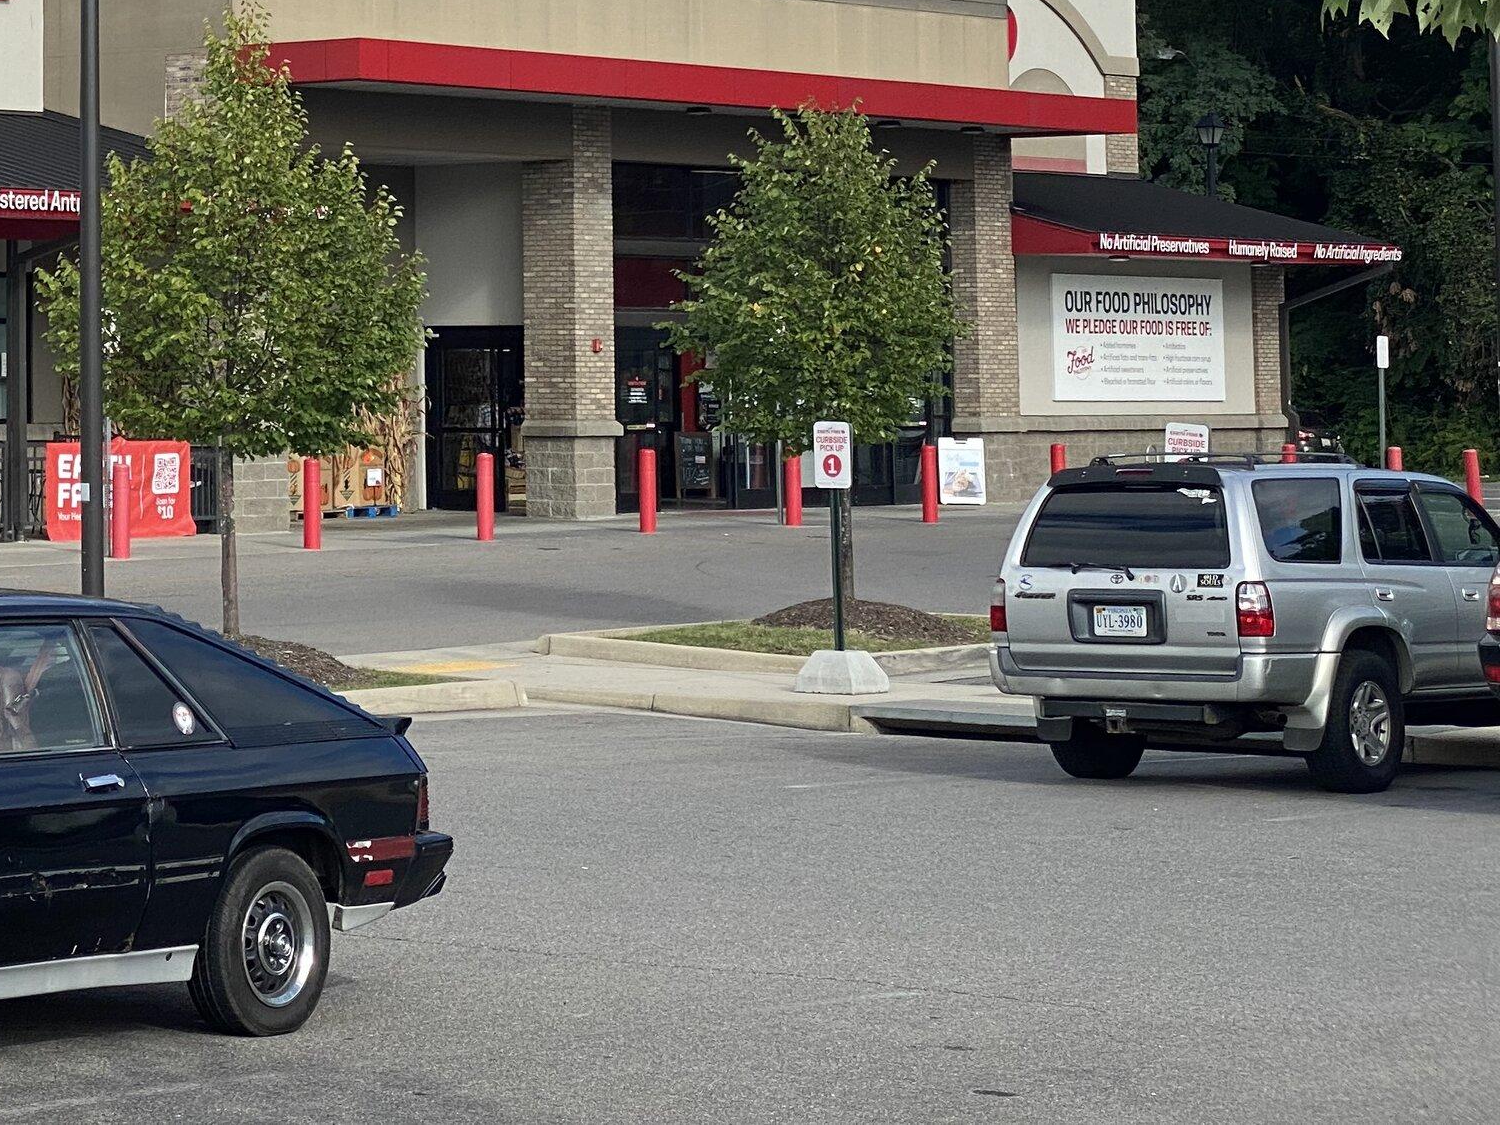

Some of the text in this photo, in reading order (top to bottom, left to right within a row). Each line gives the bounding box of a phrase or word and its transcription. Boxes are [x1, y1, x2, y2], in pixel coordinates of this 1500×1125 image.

[1100, 233, 1210, 254] No Artificial Preservatives
[1228, 239, 1298, 260] Humanely Raised
[1314, 243, 1403, 263] No Artificial Ingredients
[1064, 290, 1212, 316] OUR FOOD PHILOSOPHY
[1065, 318, 1080, 334] WE
[1082, 318, 1117, 335] PLEDGE
[1119, 320, 1138, 335] OUR
[1140, 320, 1163, 336] FOOD
[1165, 321, 1174, 336] IS
[1176, 321, 1198, 336] FREE
[1067, 345, 1095, 374] Food
[816, 436, 848, 444] CURBSIDE
[1167, 437, 1206, 449] CURBSIDE
[828, 458, 837, 474] 1
